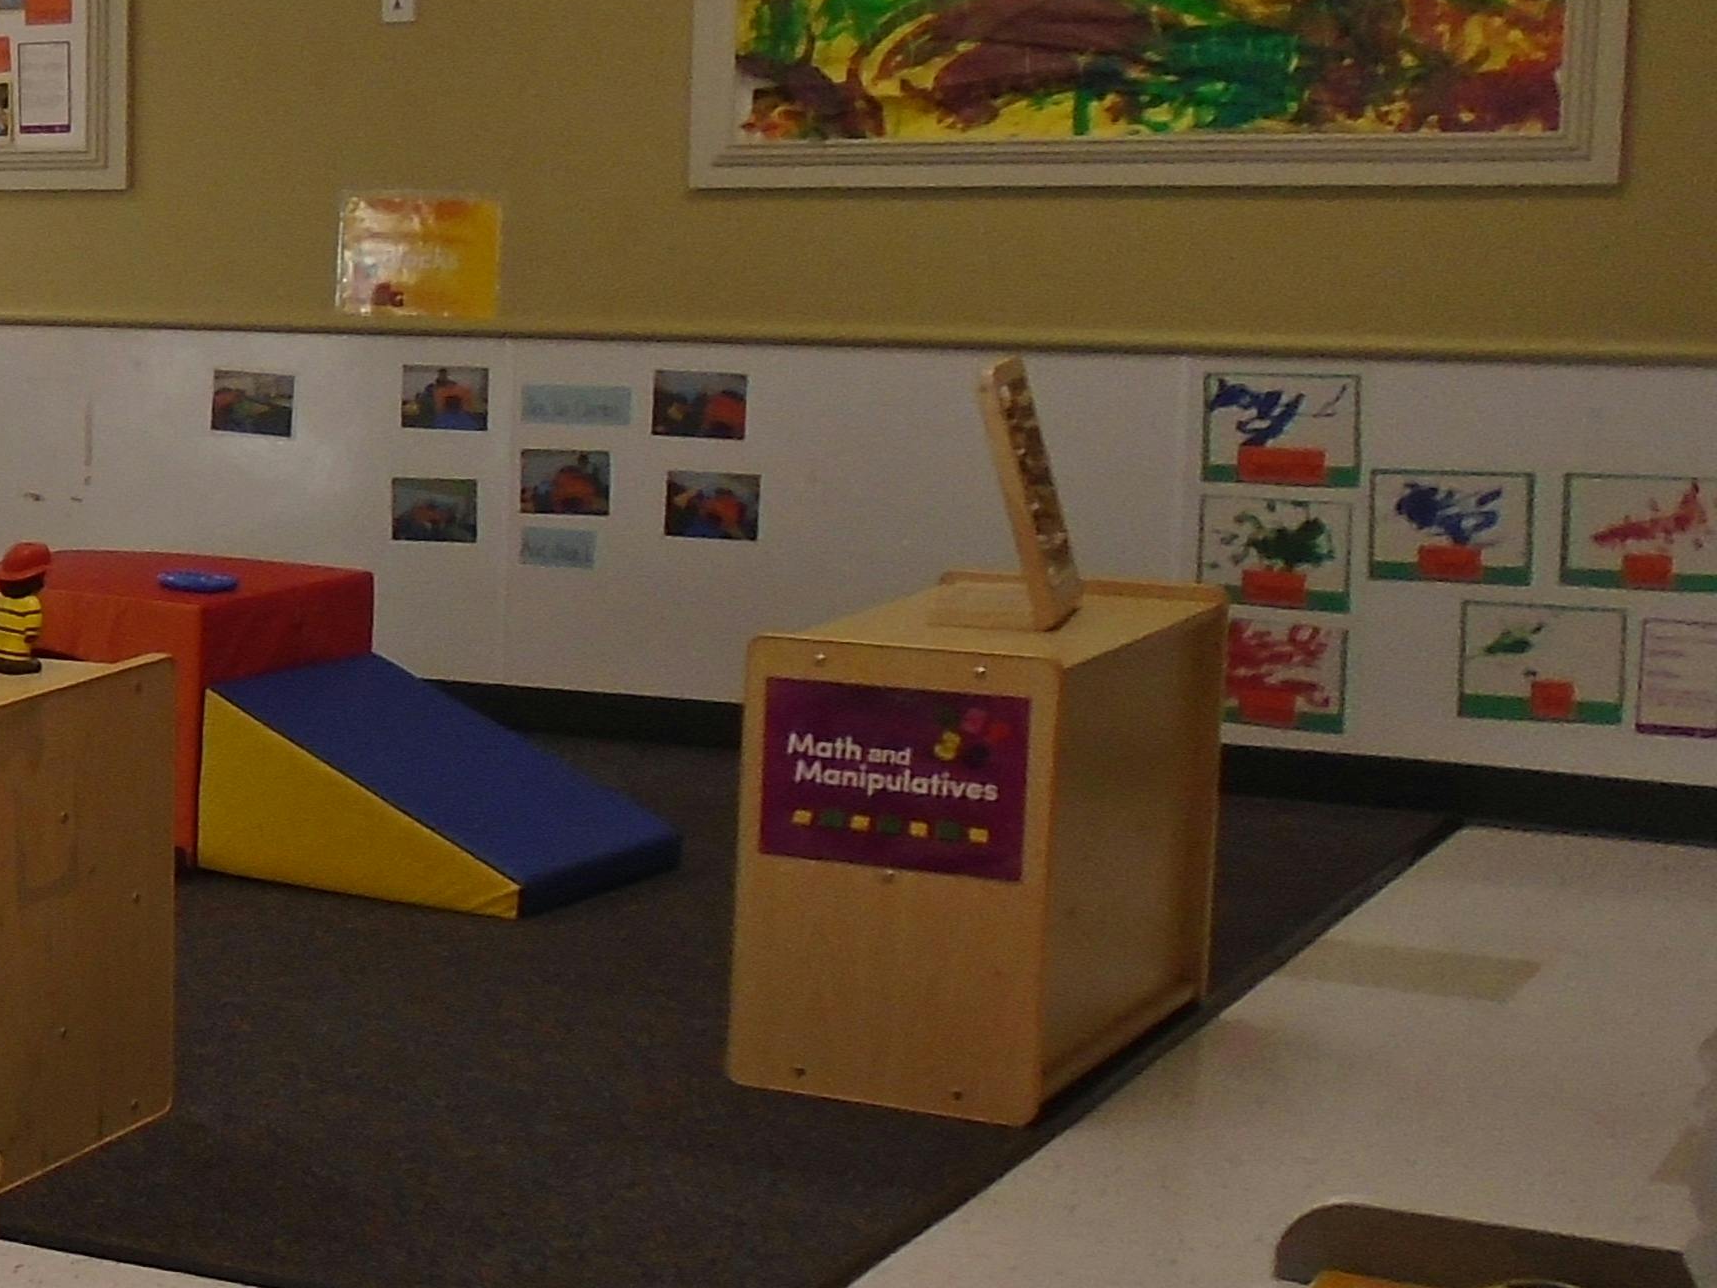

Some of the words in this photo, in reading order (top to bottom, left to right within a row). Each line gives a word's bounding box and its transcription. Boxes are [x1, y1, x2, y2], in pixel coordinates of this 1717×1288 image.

[786, 732, 862, 762] Math
[867, 746, 912, 766] and
[794, 759, 999, 802] Manipulatives
